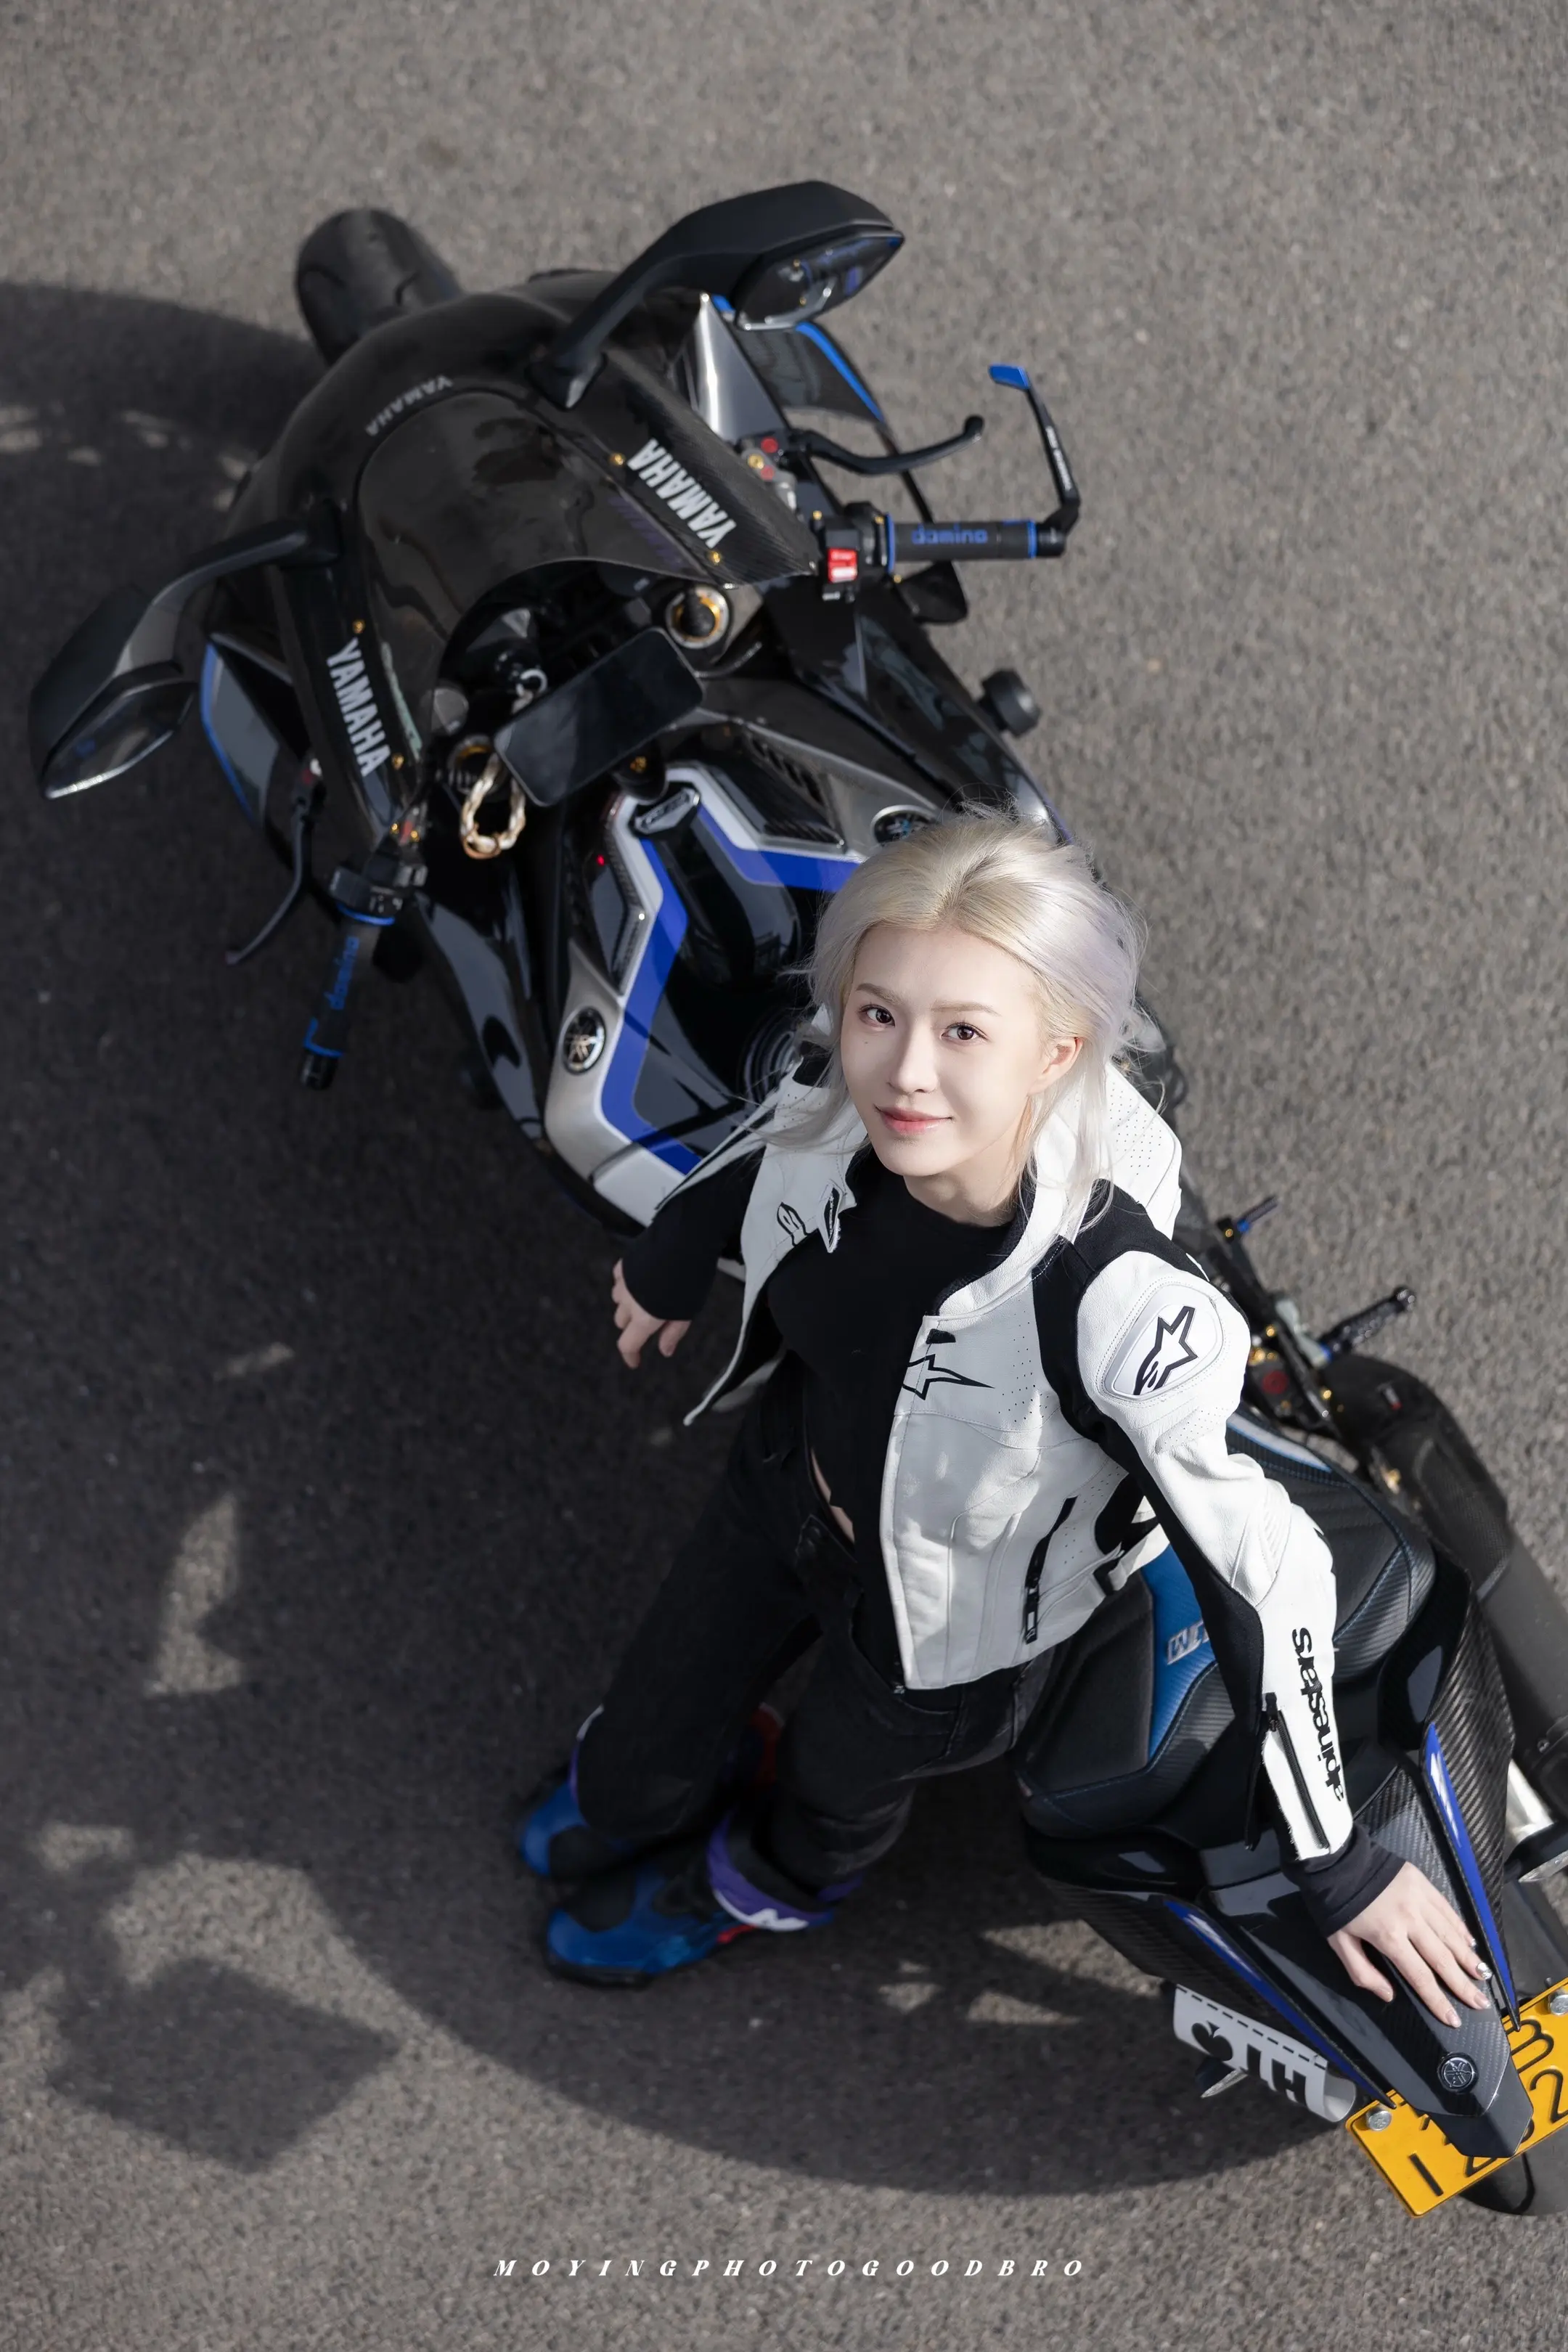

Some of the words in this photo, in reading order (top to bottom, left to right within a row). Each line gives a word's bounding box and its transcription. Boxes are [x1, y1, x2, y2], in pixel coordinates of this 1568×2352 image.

[365, 375, 454, 436] YAMAHA
[626, 437, 738, 550] YAMAHA
[911, 522, 989, 545] domino
[327, 636, 391, 777] YAMAHA
[1291, 1627, 1344, 1802] alpinestars
